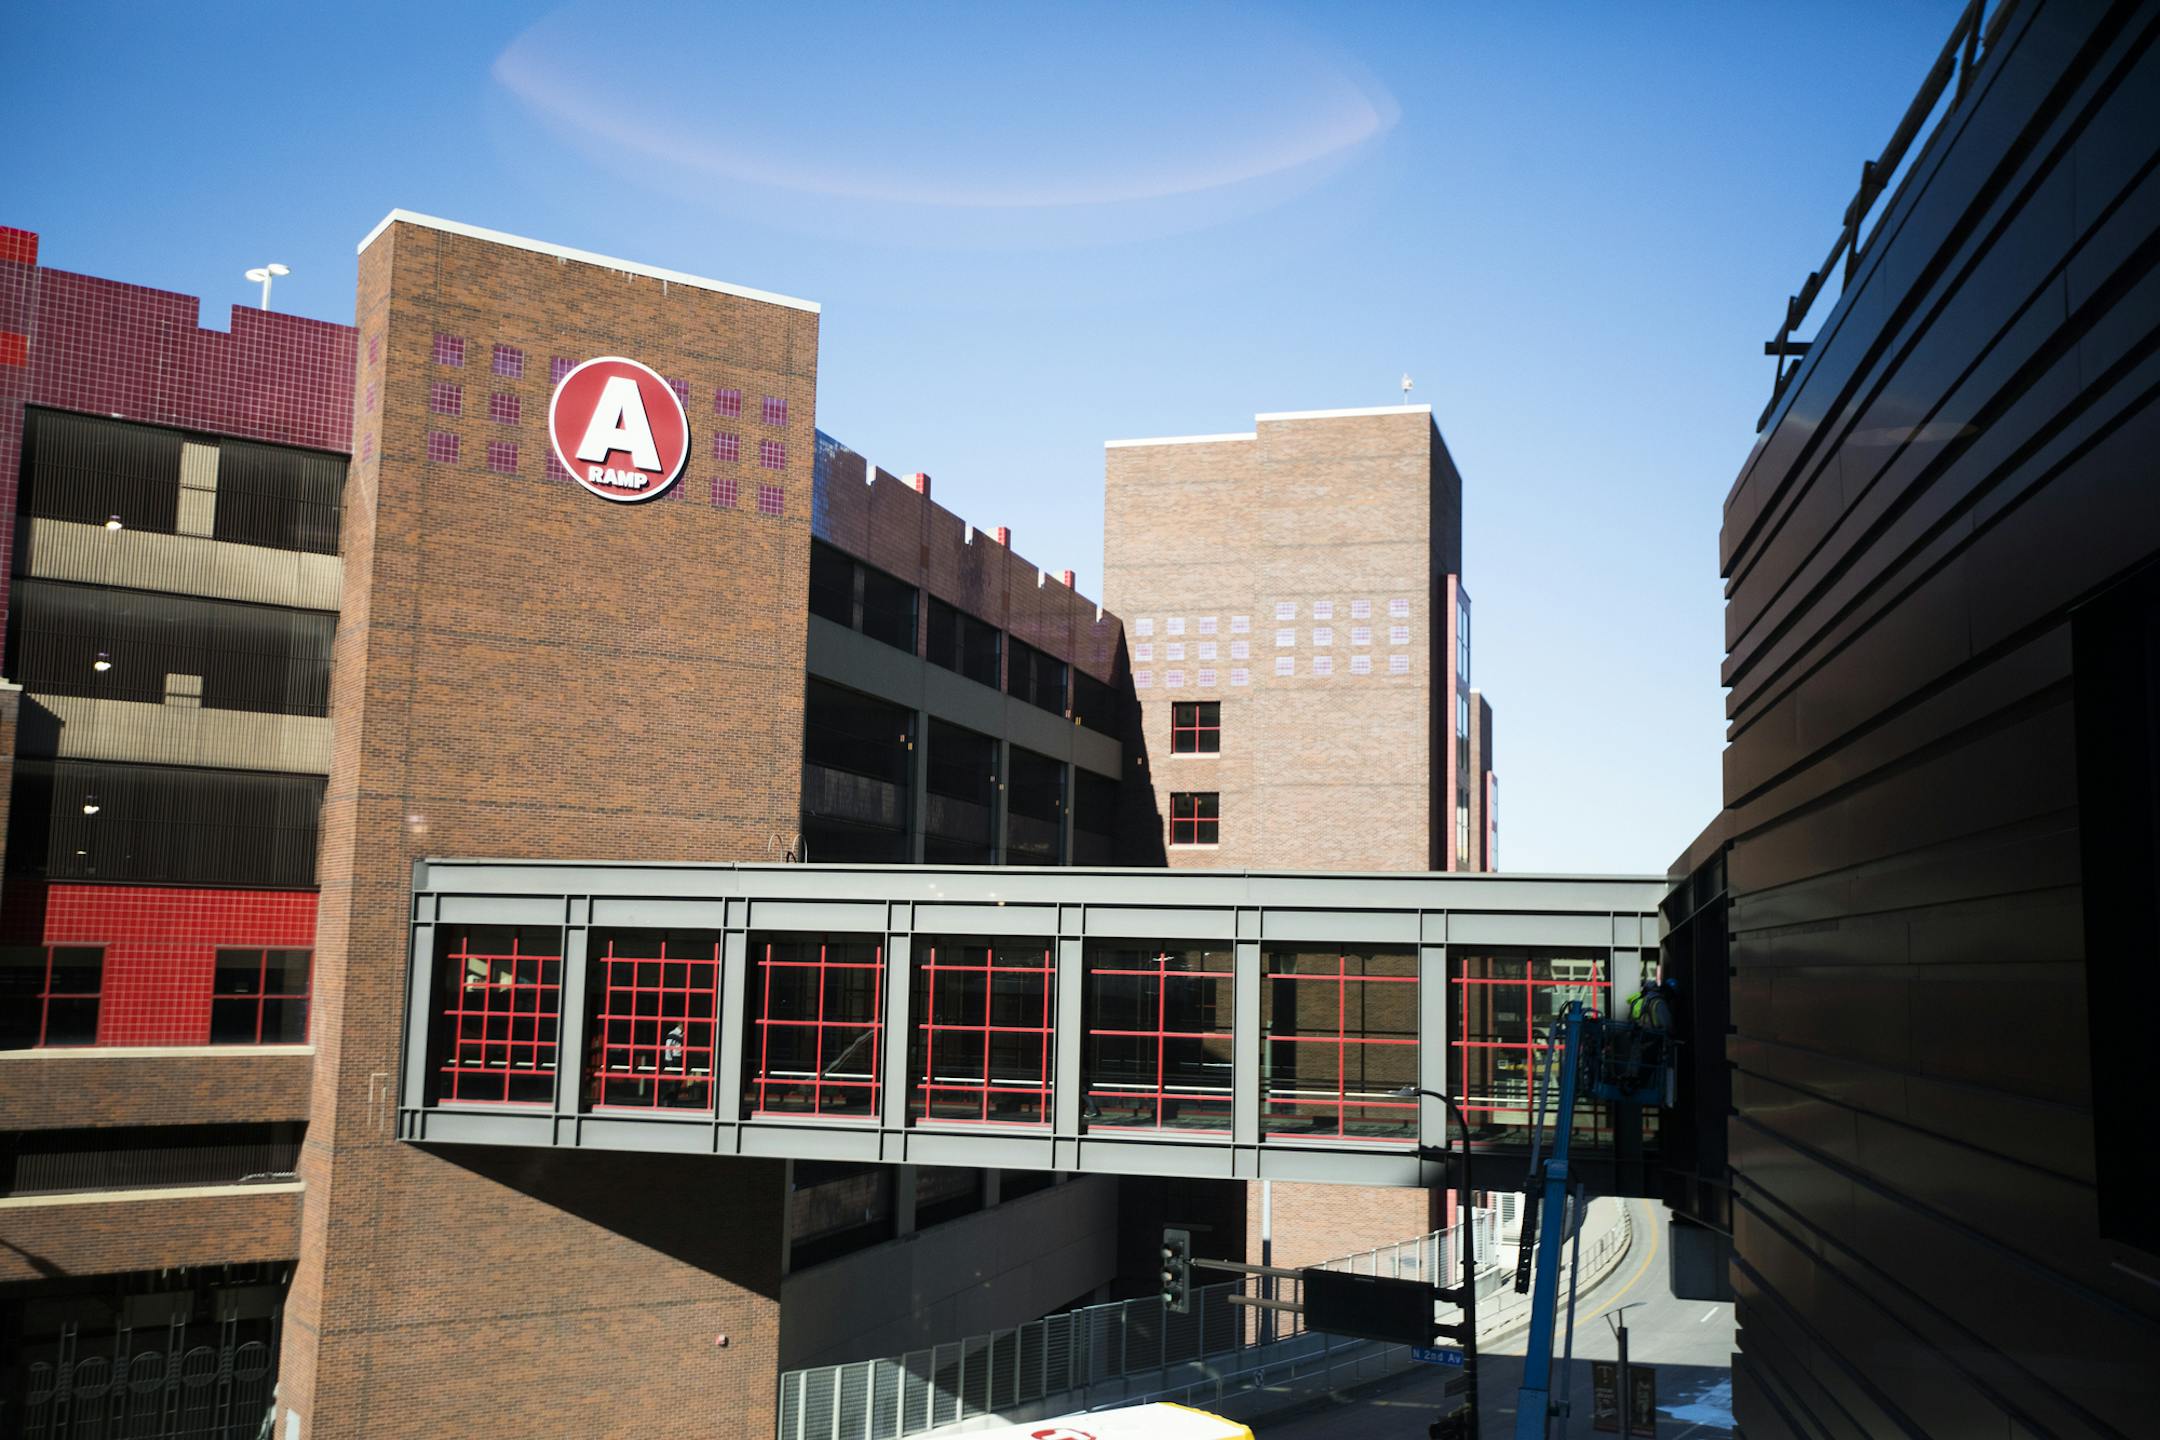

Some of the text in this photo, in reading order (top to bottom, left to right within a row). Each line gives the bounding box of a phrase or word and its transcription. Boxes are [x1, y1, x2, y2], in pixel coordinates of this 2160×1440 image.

[576, 376, 662, 472] A
[588, 465, 648, 489] RAMP
[1412, 1348, 1462, 1364] N 2nd Av
